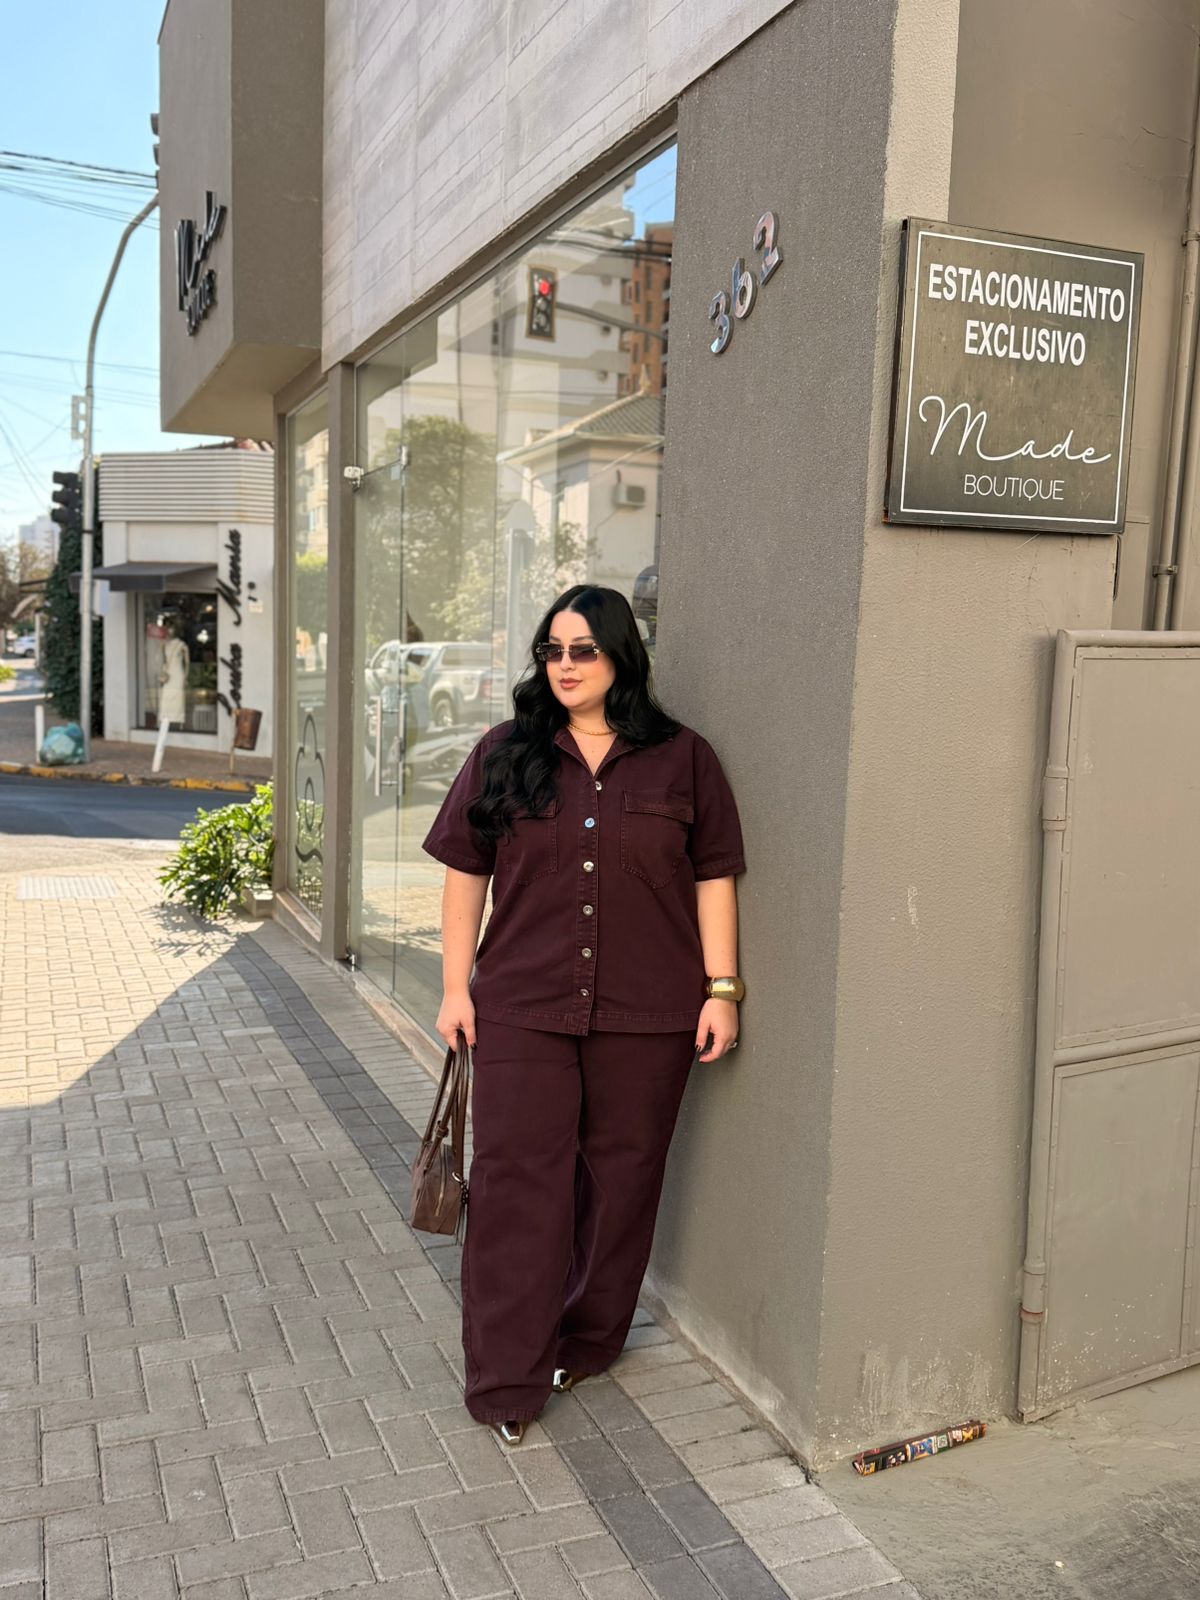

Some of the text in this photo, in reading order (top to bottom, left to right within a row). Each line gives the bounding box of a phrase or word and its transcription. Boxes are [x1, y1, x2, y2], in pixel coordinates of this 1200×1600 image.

[708, 211, 783, 354] 362
[928, 263, 1126, 323] ESTACIONAMENTO
[964, 319, 1086, 366] EXCLUSIVO
[918, 394, 1112, 465] Made
[963, 474, 1065, 502] BOUTIQUE
